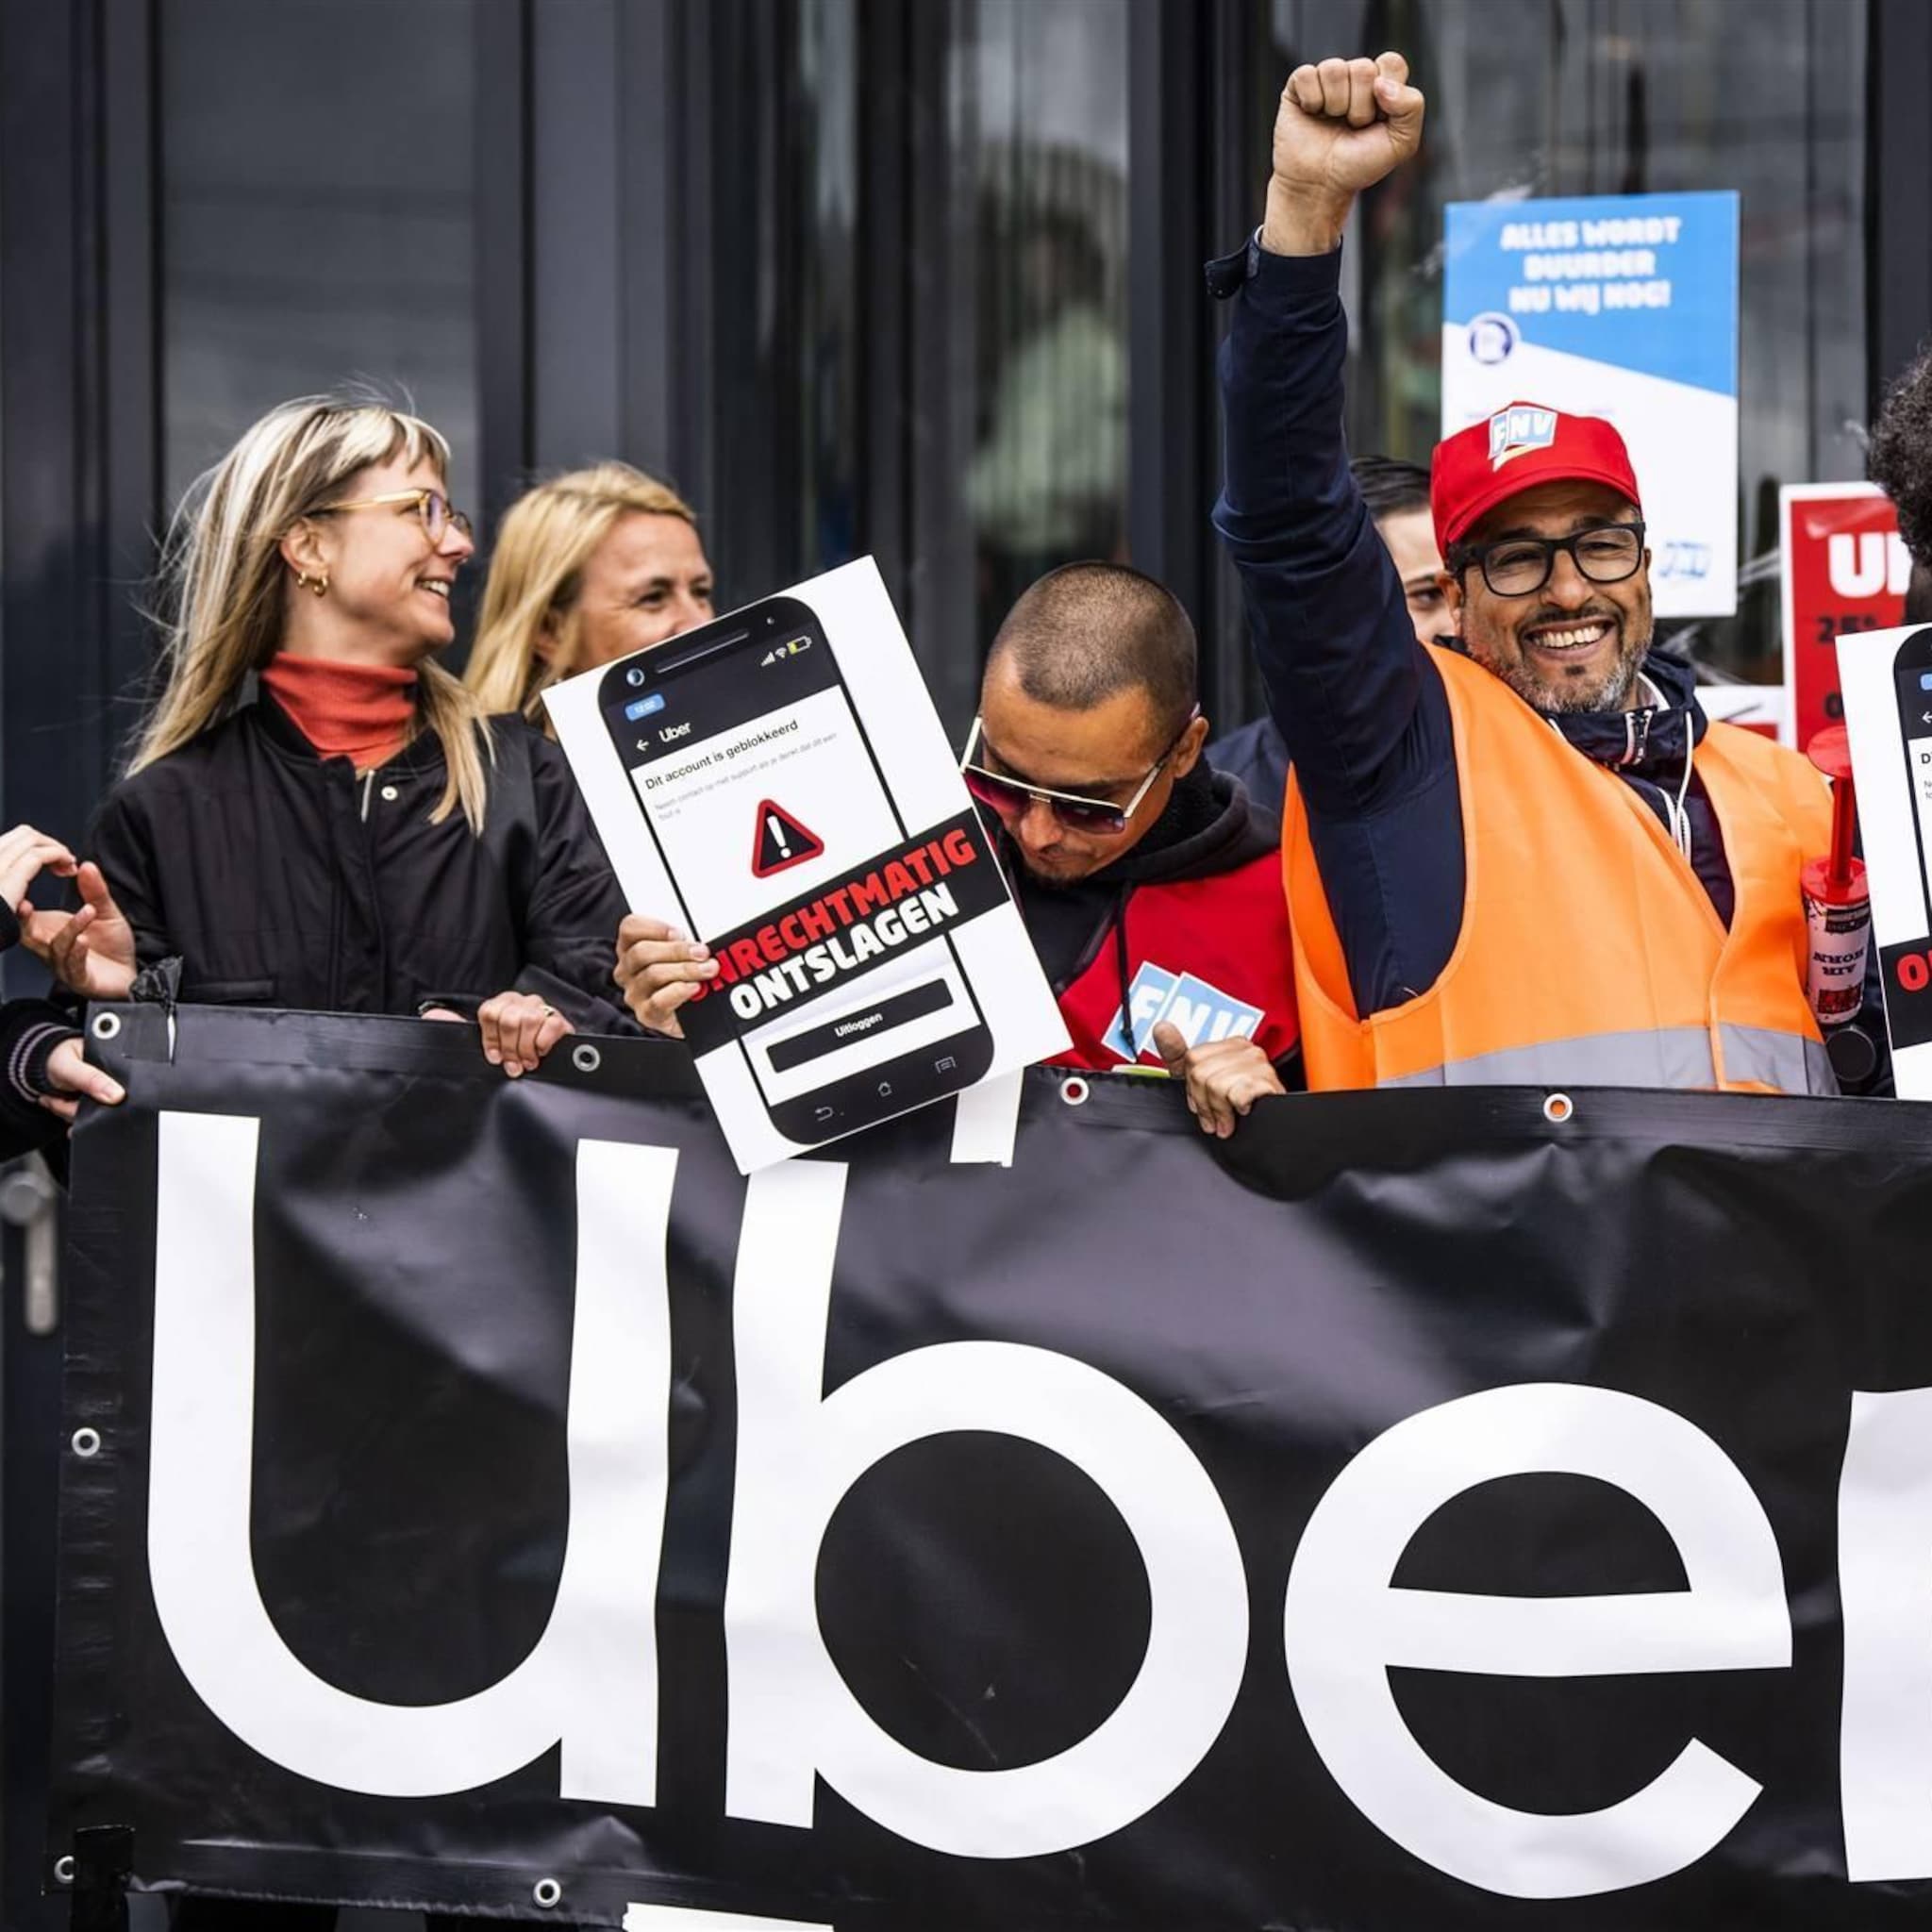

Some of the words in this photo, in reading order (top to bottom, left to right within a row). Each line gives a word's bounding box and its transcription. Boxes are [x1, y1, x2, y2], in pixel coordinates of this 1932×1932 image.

[1500, 222, 1579, 251] ALLES
[1524, 250, 1657, 281] DUURDER
[1509, 286, 1551, 312] NU
[1491, 412, 1554, 457] FNV
[658, 722, 691, 742] Uber
[645, 774, 663, 791] Dit
[665, 756, 712, 783] account
[714, 751, 724, 763] is
[726, 719, 799, 759] geblokkeerd
[1921, 751, 1932, 764] D
[729, 881, 960, 1020] ONTSLAGEN
[1812, 947, 1865, 964] HORN
[1822, 964, 1857, 976] AIR
[834, 1011, 884, 1038] Uitloggen
[1121, 984, 1257, 1049] FNV
